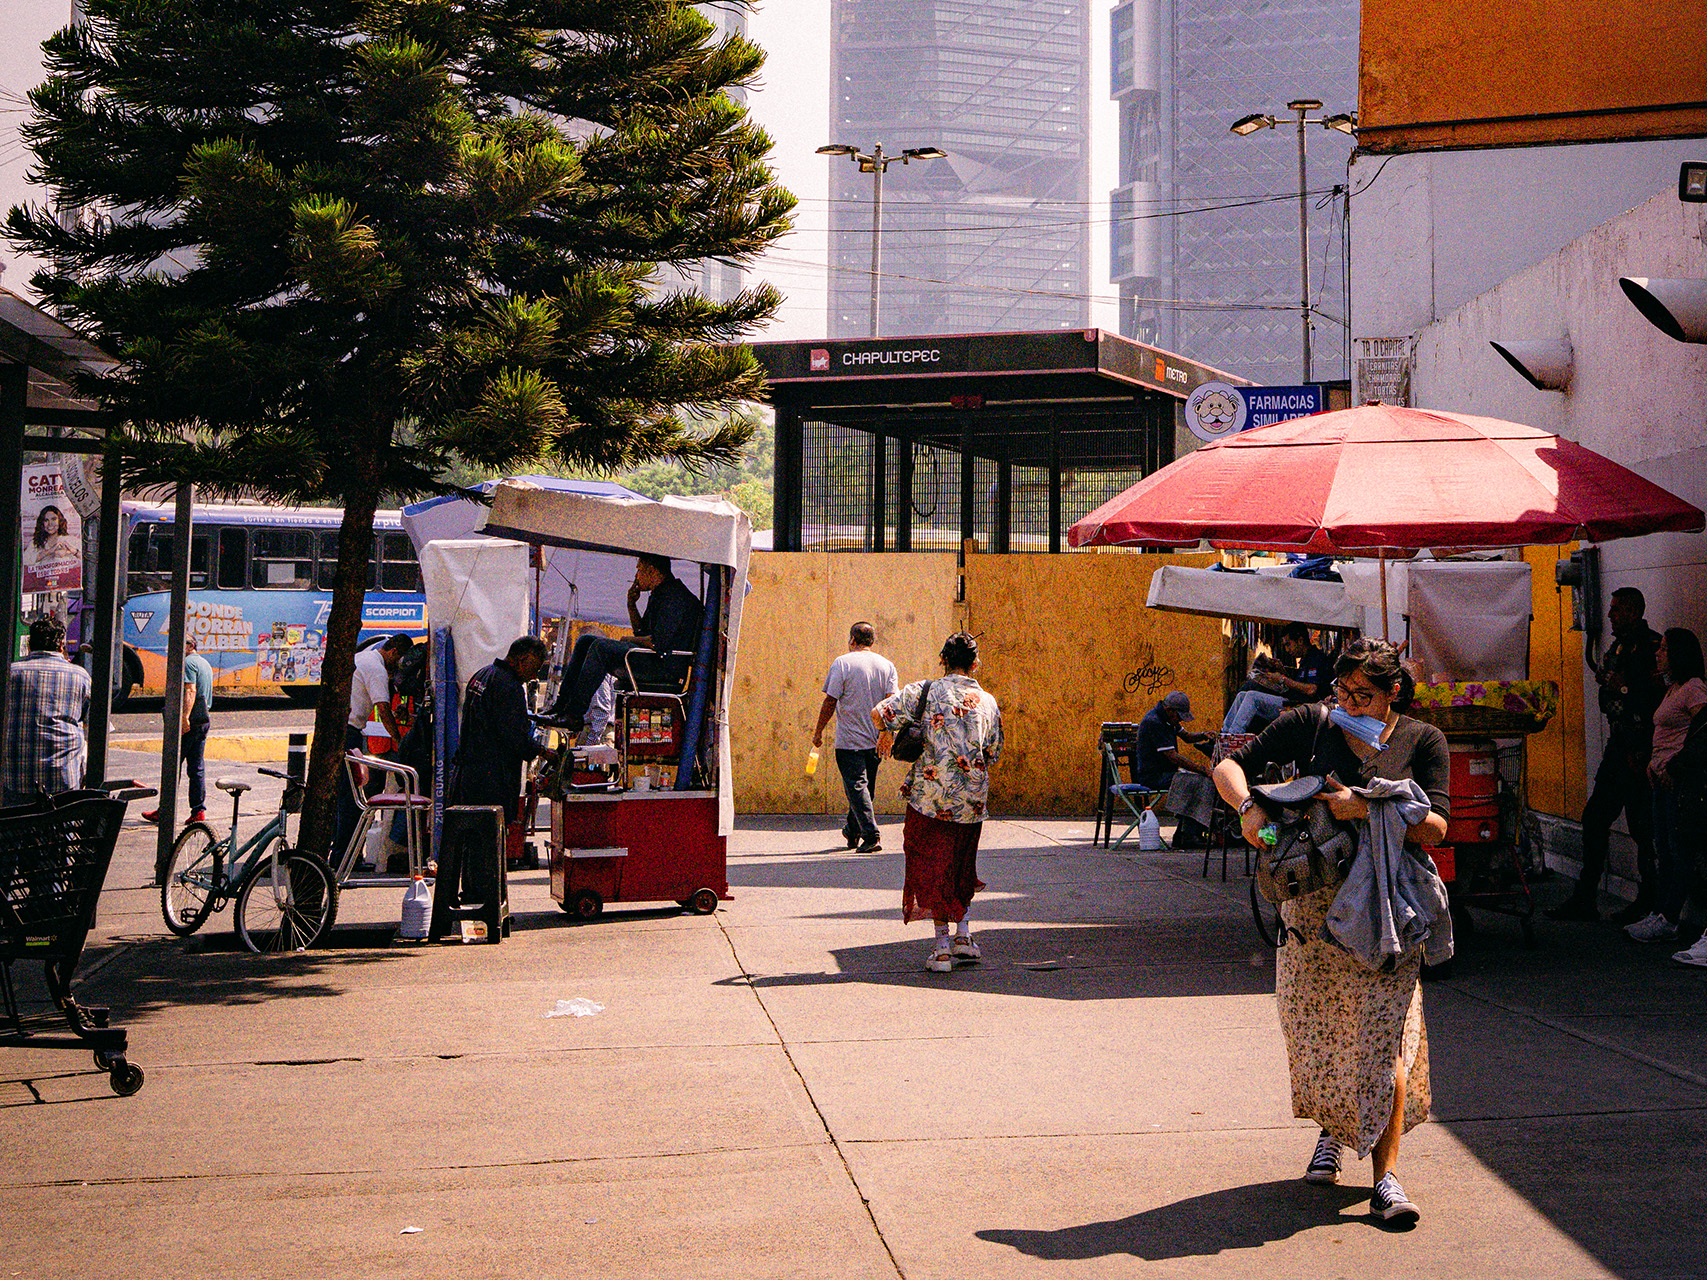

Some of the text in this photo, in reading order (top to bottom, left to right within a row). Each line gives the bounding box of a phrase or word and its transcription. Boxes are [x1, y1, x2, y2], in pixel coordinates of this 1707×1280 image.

[842, 349, 940, 365] CHAPULTEPEC
[1369, 361, 1399, 371] CARNITAS
[1165, 366, 1188, 384] METRO
[1373, 385, 1397, 396] TORTAS
[1249, 394, 1315, 410] FARMACIAS
[1253, 412, 1313, 427] SIMILA
[365, 608, 417, 617] SCORPION
[435, 760, 444, 825] ZHU GUANG
